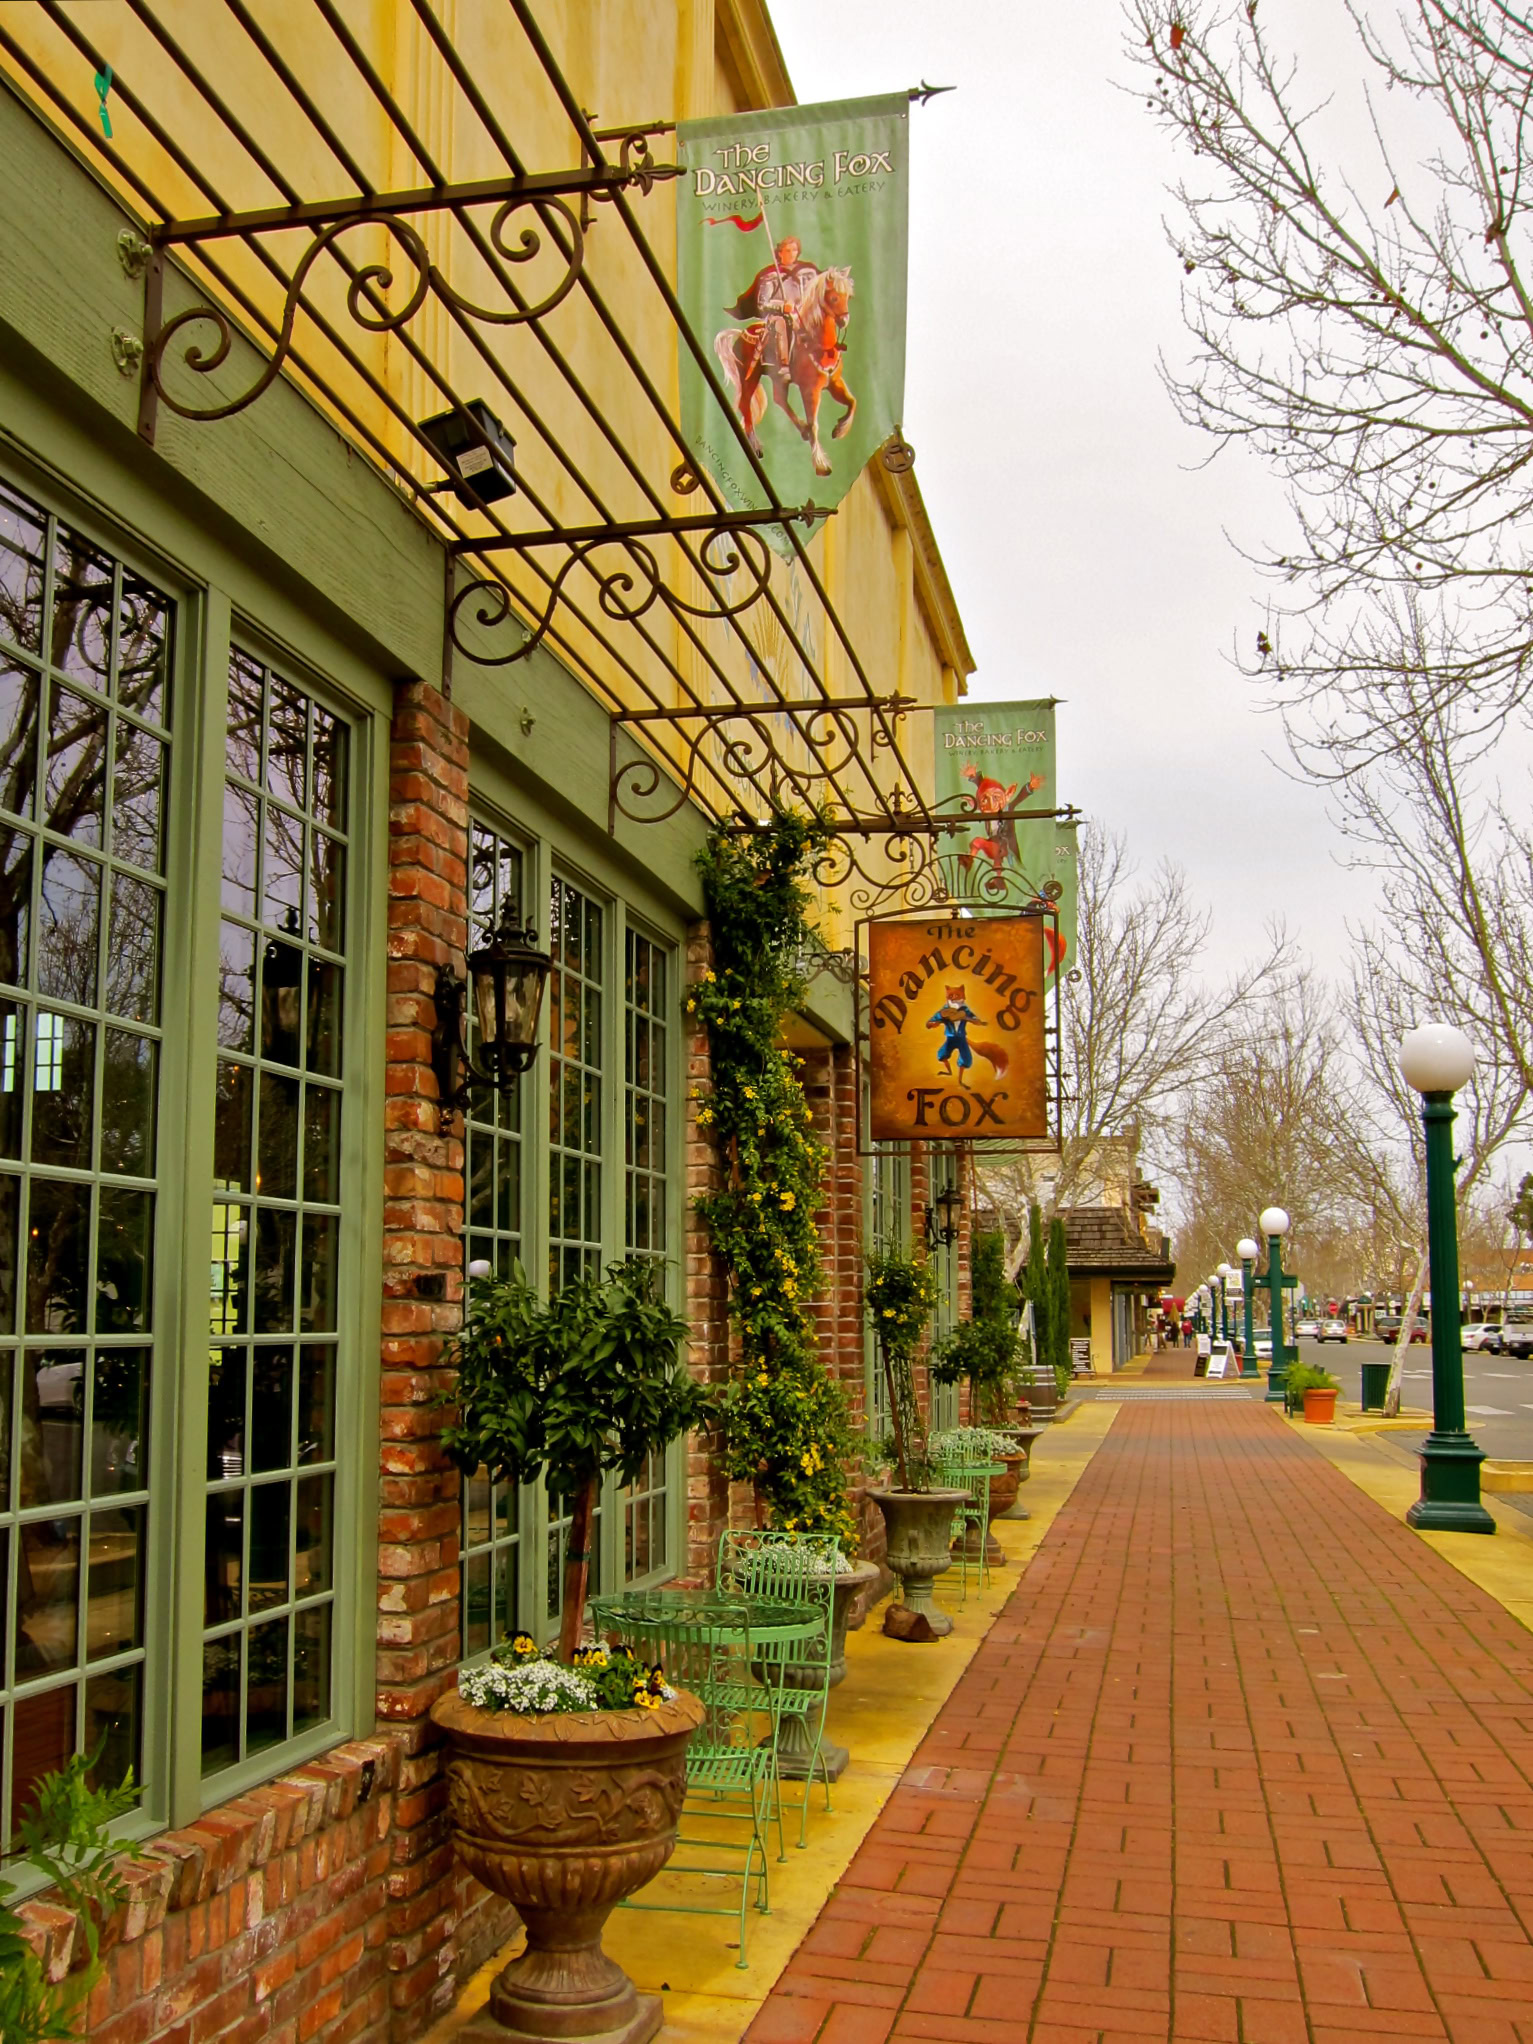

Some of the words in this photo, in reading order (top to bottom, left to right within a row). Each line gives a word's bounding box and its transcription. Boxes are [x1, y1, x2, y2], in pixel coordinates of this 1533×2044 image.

[715, 142, 770, 168] The
[694, 161, 824, 196] DANCING
[764, 191, 819, 205] BAKERY
[824, 191, 832, 200] &
[838, 181, 886, 198] EATERY
[955, 720, 984, 733] The
[944, 733, 1012, 749] DANCING
[927, 923, 976, 940] The
[873, 944, 1037, 1035] Dancing
